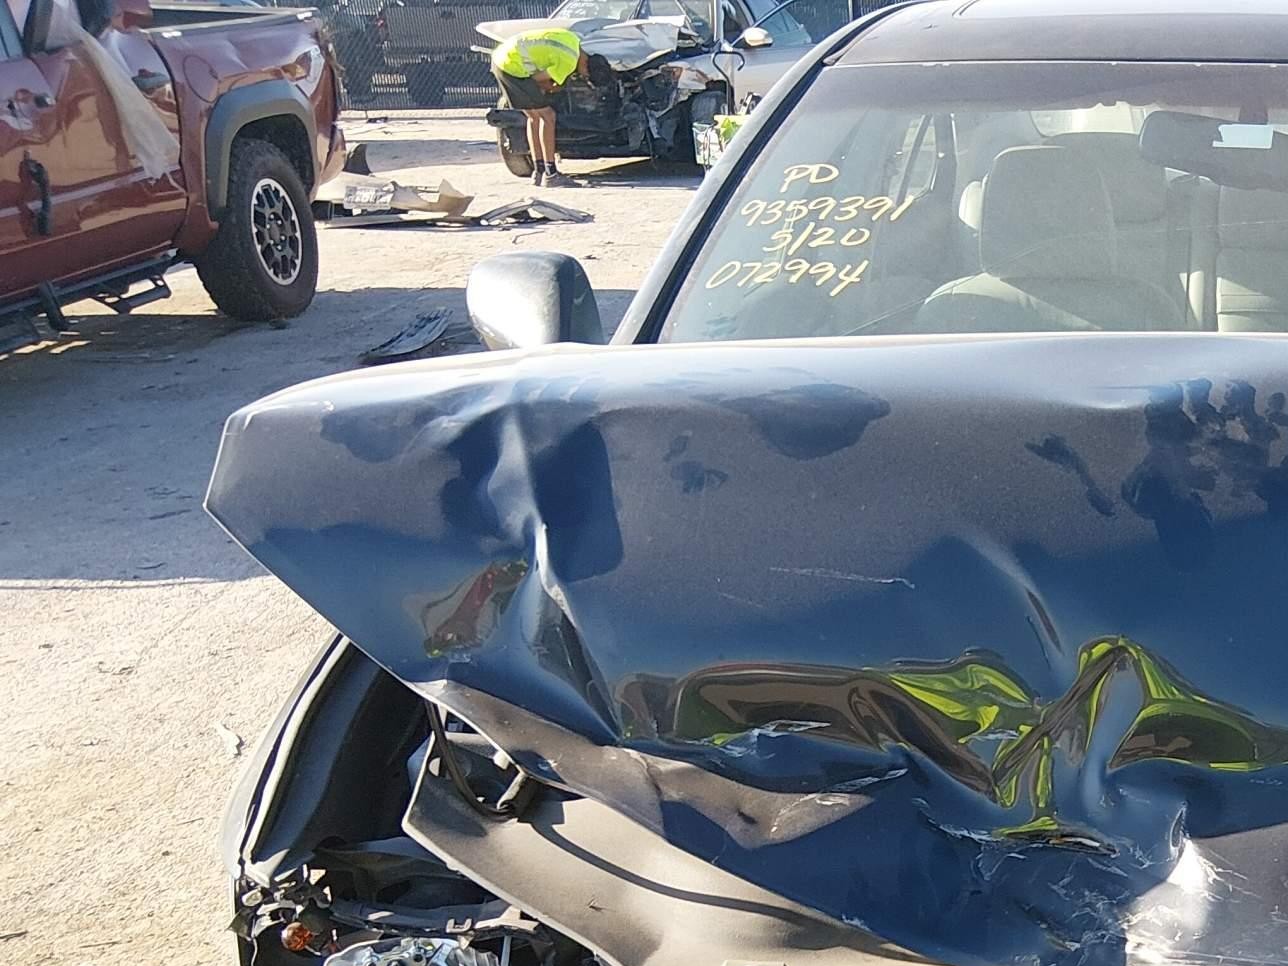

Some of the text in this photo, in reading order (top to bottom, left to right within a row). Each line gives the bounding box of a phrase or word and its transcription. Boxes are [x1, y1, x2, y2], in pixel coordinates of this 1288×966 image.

[780, 163, 839, 193] PD
[740, 195, 916, 226] 9359391
[763, 221, 870, 255] 5/20
[705, 259, 869, 297] 072994
